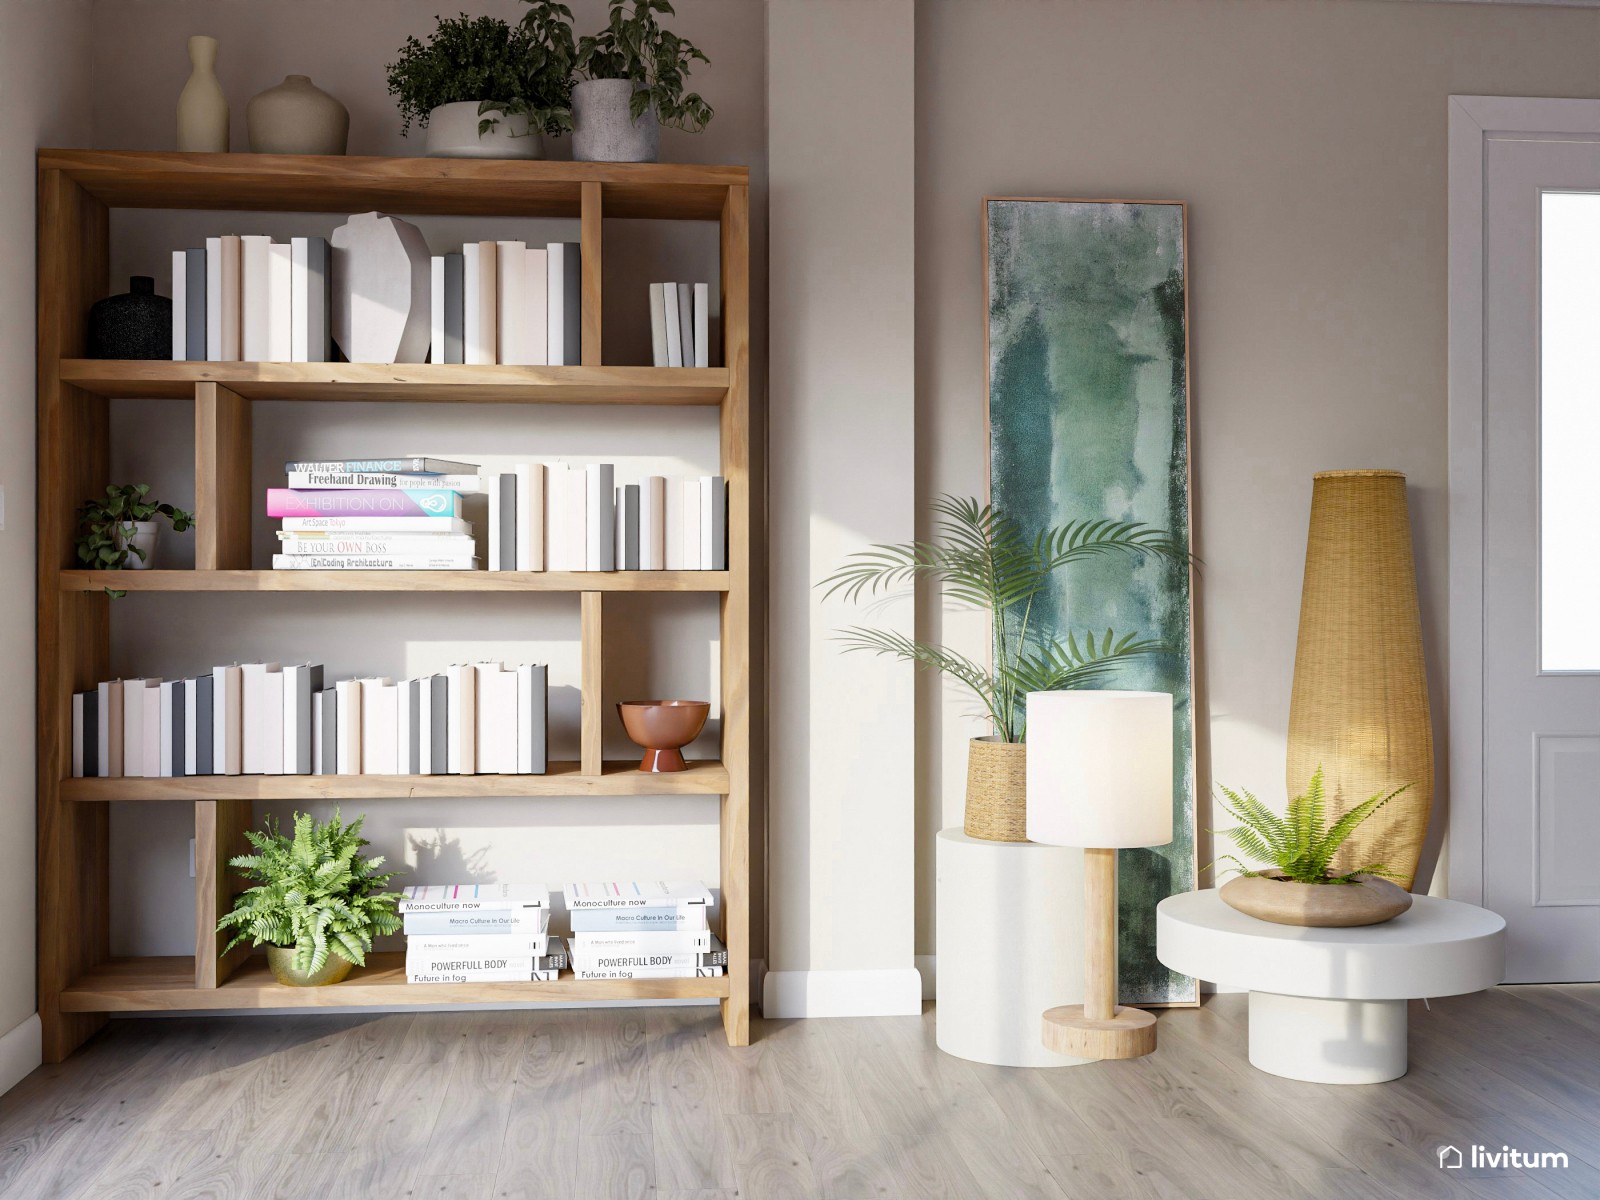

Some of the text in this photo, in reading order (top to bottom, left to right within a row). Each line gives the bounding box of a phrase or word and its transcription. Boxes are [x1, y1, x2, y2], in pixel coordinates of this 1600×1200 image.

[293, 461, 402, 473] WALTER FINANCE
[308, 473, 354, 485] Freehand
[357, 474, 398, 488] Drawing
[285, 497, 404, 510] EXHIBITION ON
[329, 519, 346, 528] Tokyo
[297, 541, 387, 553] BE YOUR OWN BOSS
[405, 902, 460, 911] Monoculture
[431, 961, 482, 971] POWERFULL
[484, 960, 507, 969] BODY
[598, 957, 648, 968] POWERFULL
[649, 956, 673, 965] BODY
[442, 974, 450, 982] in
[452, 974, 467, 982] fog
[609, 970, 617, 978] in
[619, 970, 633, 978] fog
